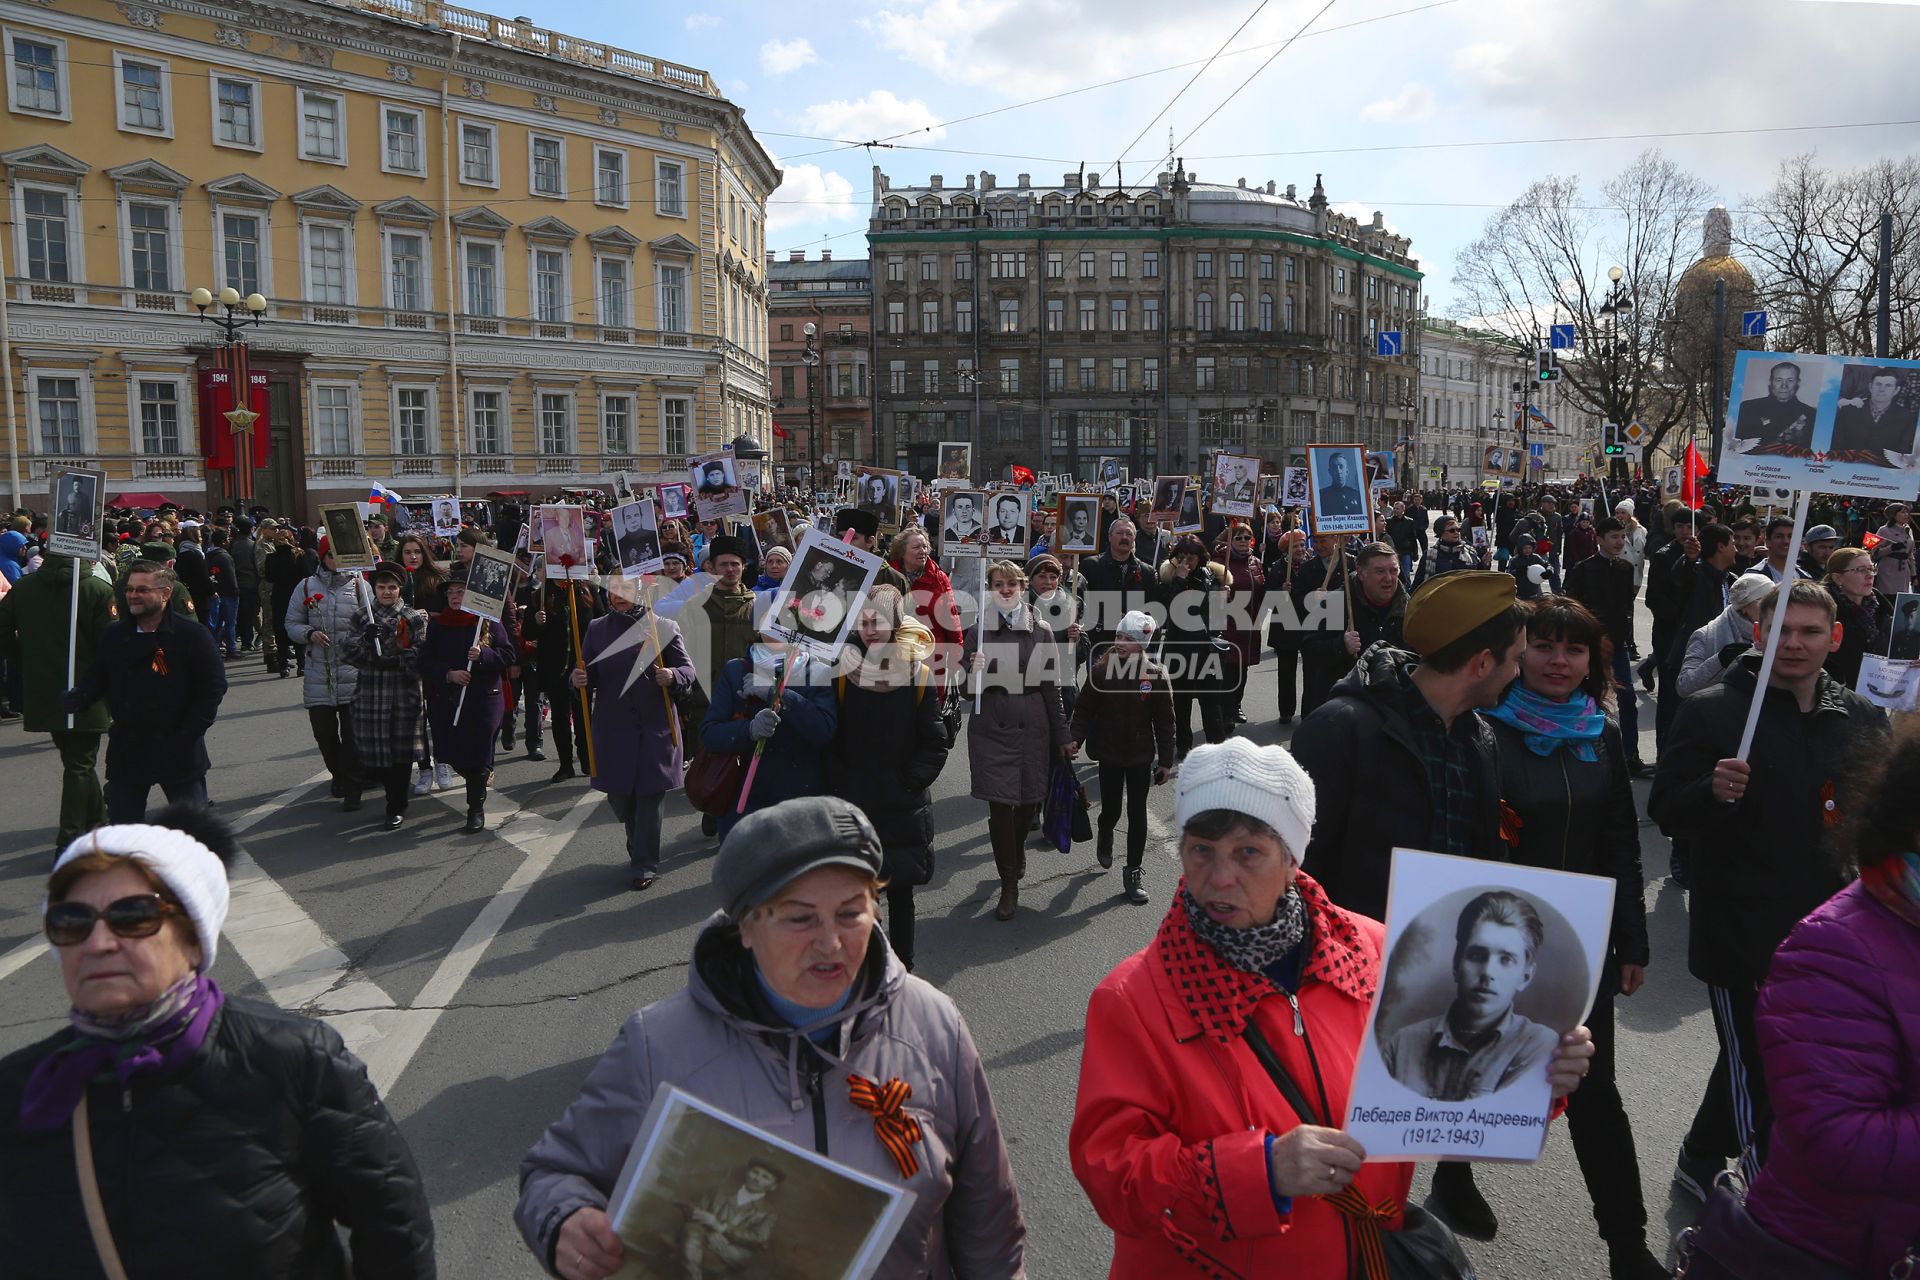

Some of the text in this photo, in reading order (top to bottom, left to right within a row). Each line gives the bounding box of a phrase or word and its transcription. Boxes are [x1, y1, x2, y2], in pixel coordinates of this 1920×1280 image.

[212, 374, 228, 382] 1941
[250, 375, 267, 384] 1945
[1350, 1106, 1546, 1129] Лебедев Виктор Андреевич
[1402, 1128, 1485, 1148] (1912-1943)
